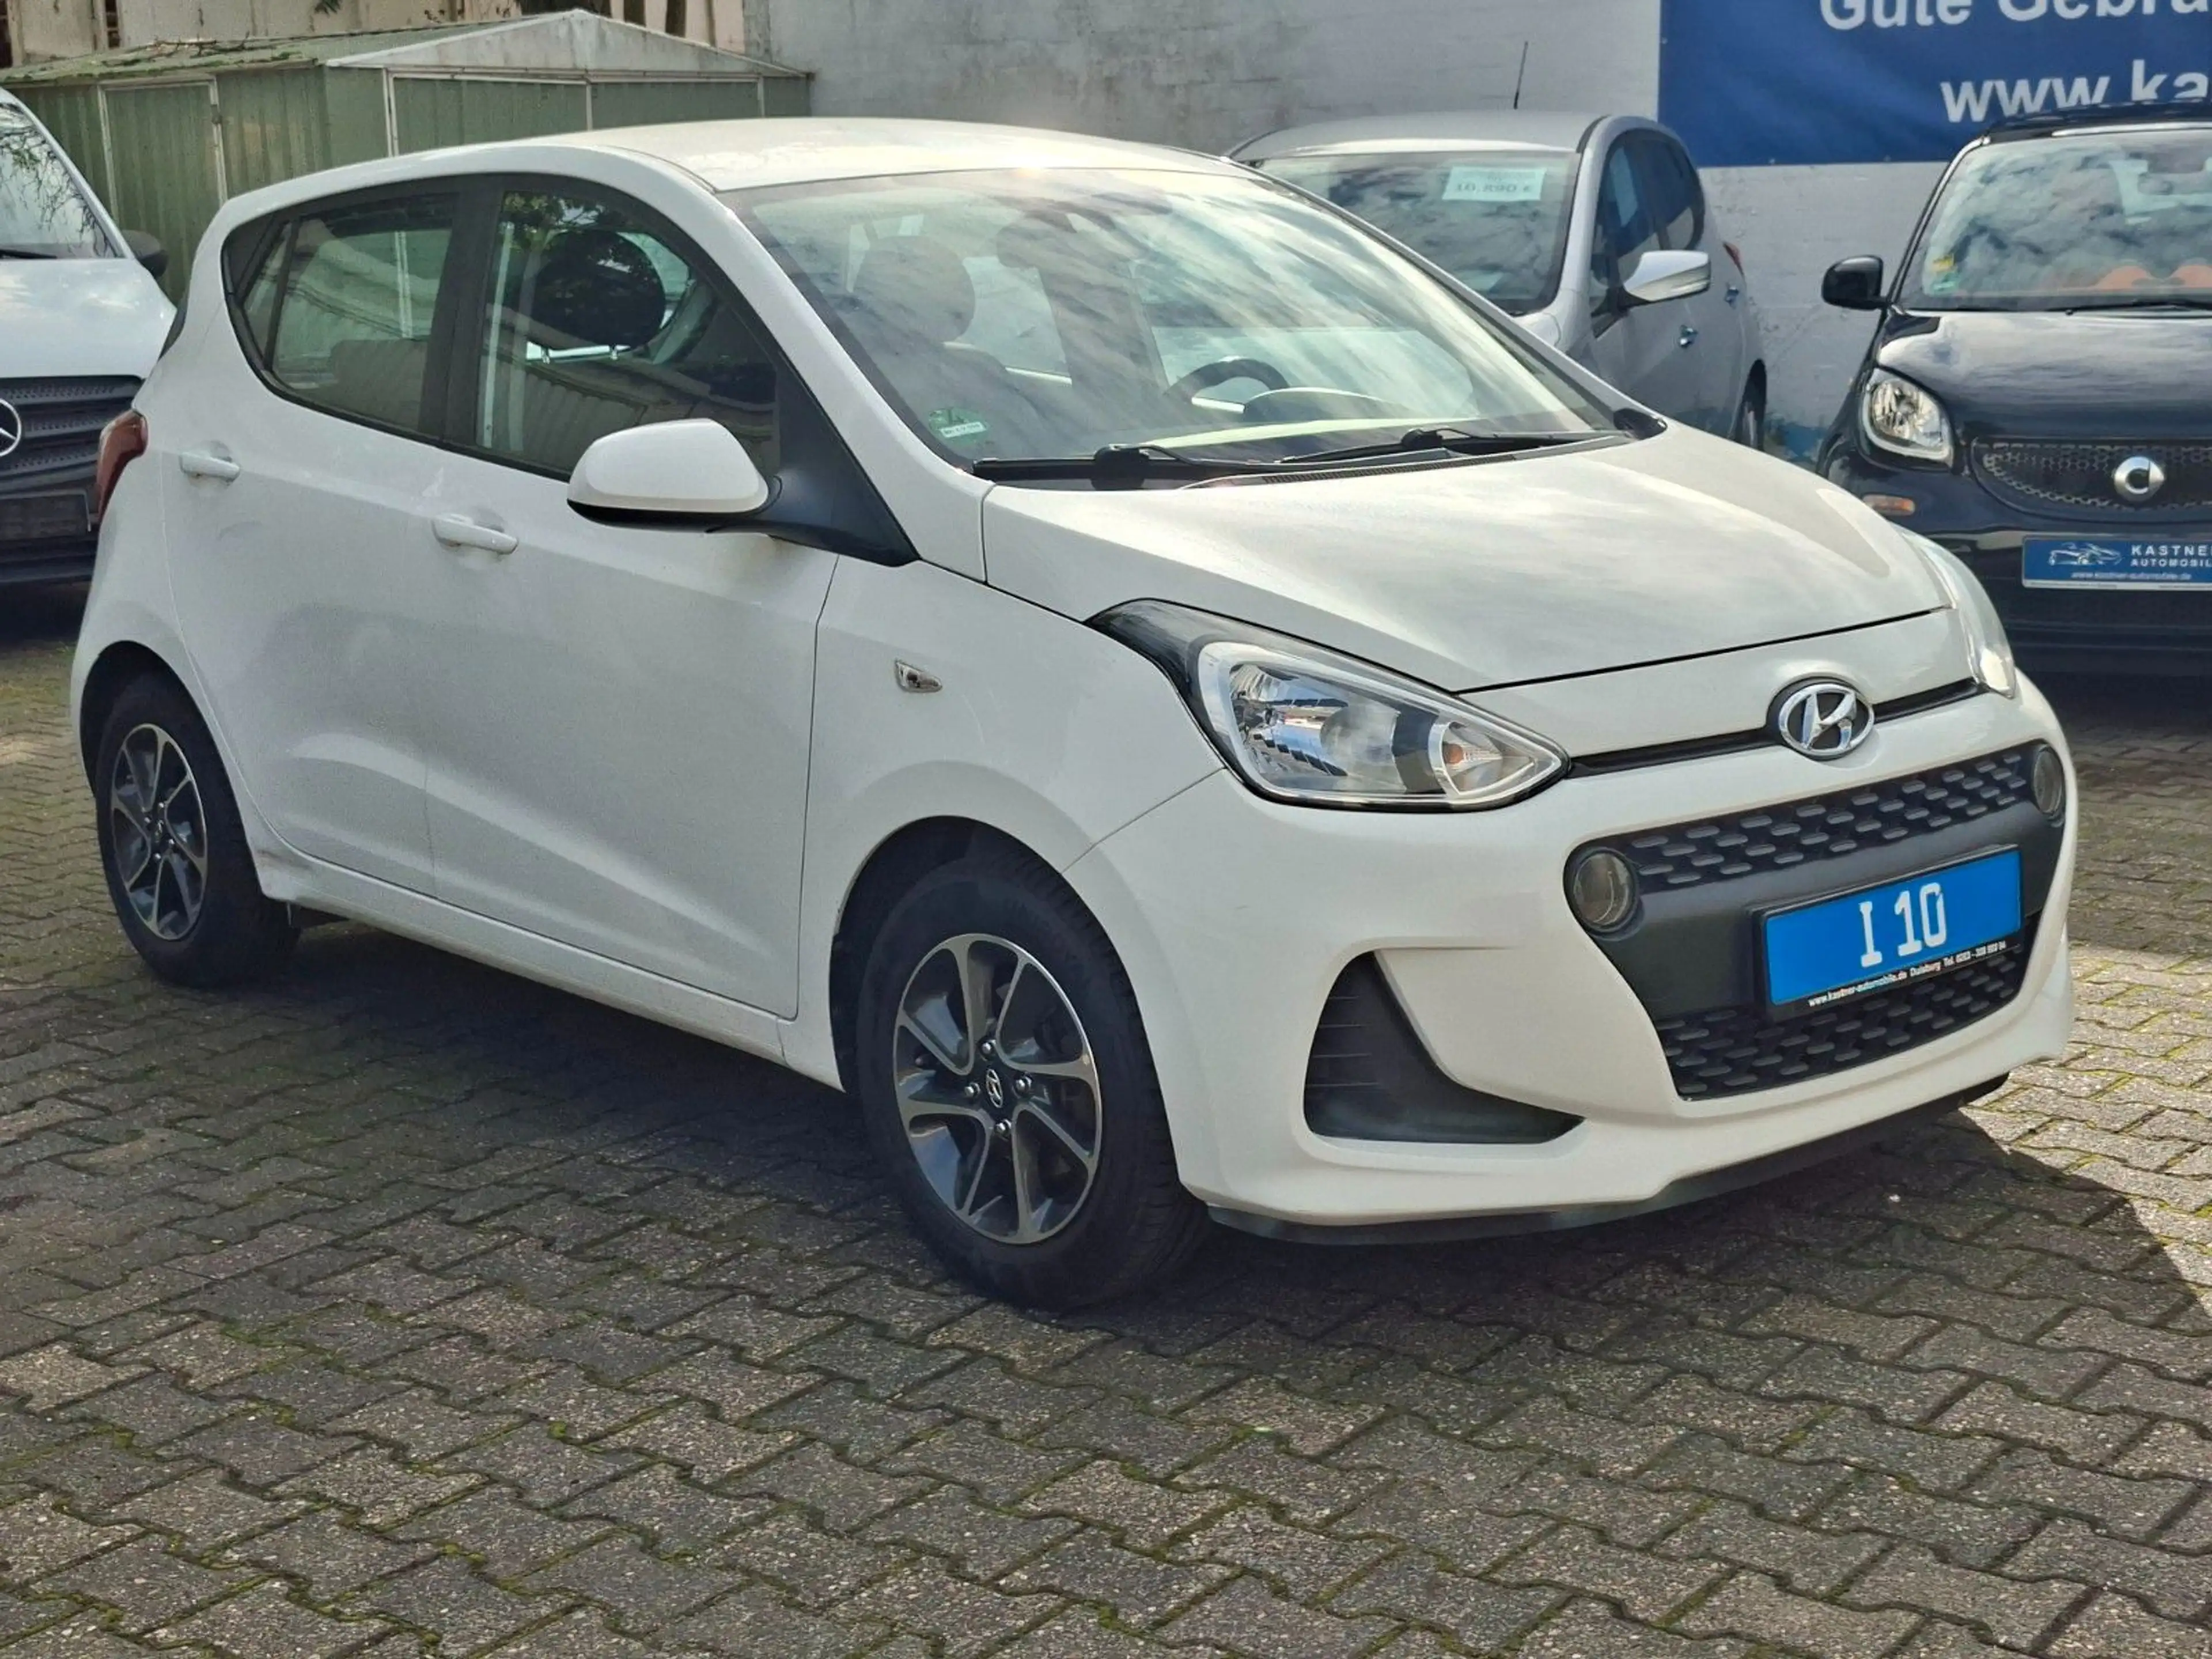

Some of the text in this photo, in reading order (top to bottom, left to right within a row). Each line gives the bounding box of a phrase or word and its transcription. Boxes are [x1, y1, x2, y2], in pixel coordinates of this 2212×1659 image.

[1940, 58, 2210, 123] wwwka
[2131, 544, 2212, 556] KASTNE
[1894, 882, 1947, 957] 10
